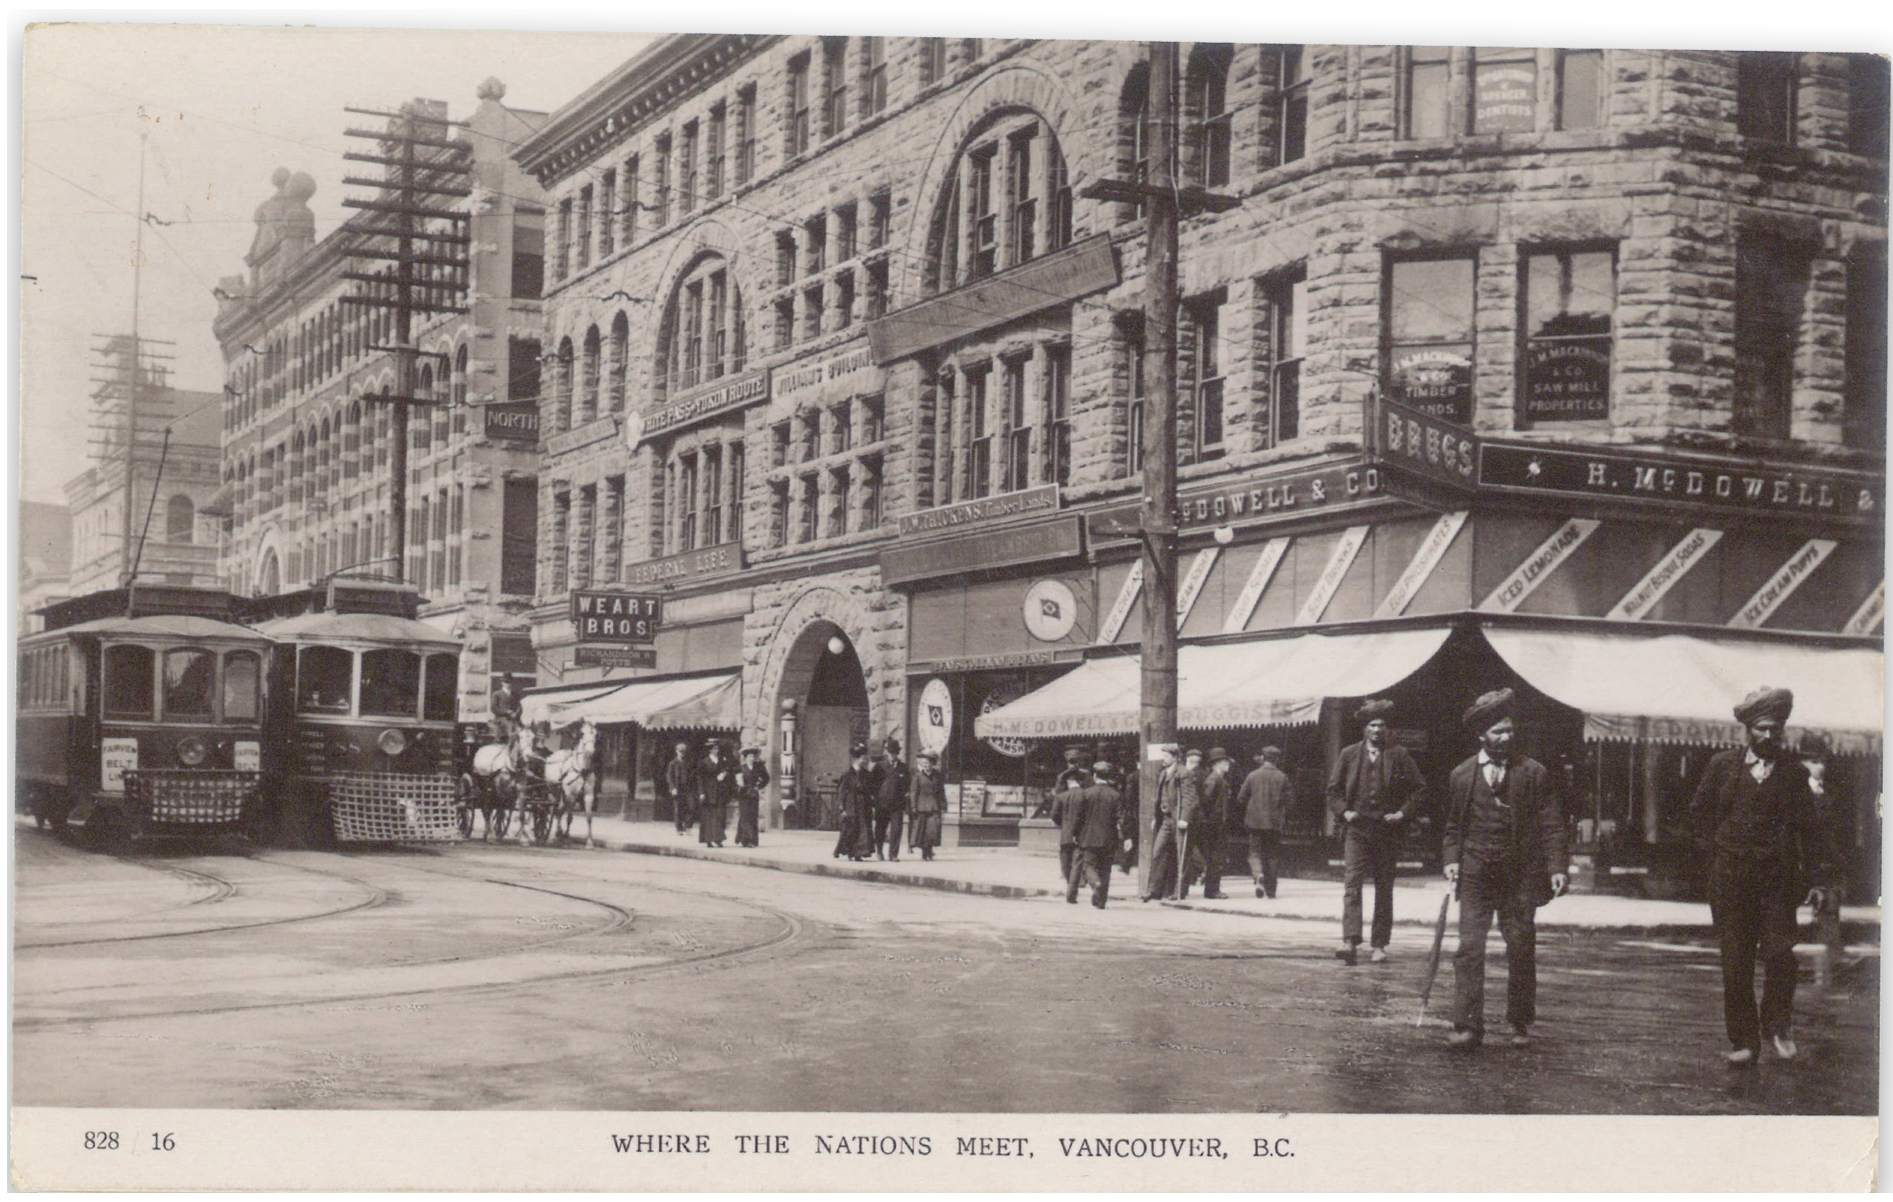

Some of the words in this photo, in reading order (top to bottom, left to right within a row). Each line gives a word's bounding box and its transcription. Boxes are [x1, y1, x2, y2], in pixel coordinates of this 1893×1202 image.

[1477, 104, 1531, 119] DENTISTS
[1405, 386, 1456, 397] TIMBER
[1534, 382, 1562, 393] SAW
[1568, 381, 1599, 392] MILL
[644, 412, 665, 433] HITE
[667, 401, 691, 422] PASS
[696, 388, 729, 412] YUKON
[729, 375, 764, 400] ROUTE
[1419, 404, 1458, 414] ANDS.
[487, 411, 539, 429] NORTH
[1388, 412, 1473, 476] DRUGS
[1312, 479, 1325, 500] &
[1347, 469, 1378, 495] CO
[1588, 463, 1617, 487] H.
[1858, 489, 1874, 510] &
[986, 501, 1019, 517] Timber
[1676, 535, 1705, 568] SODAS
[636, 559, 687, 582] FEDERAL
[1500, 579, 1523, 606] ICED
[1523, 523, 1581, 582] LEMONADE
[579, 597, 655, 615] WEART
[1744, 604, 1761, 622] ICE
[588, 618, 646, 635] BROS
[580, 649, 640, 658] RICHARDSON
[600, 658, 631, 666] POTTS
[993, 722, 1007, 733] H.
[1124, 716, 1134, 727] C
[102, 744, 137, 754] FAIRVIEW
[106, 760, 132, 768] BELT
